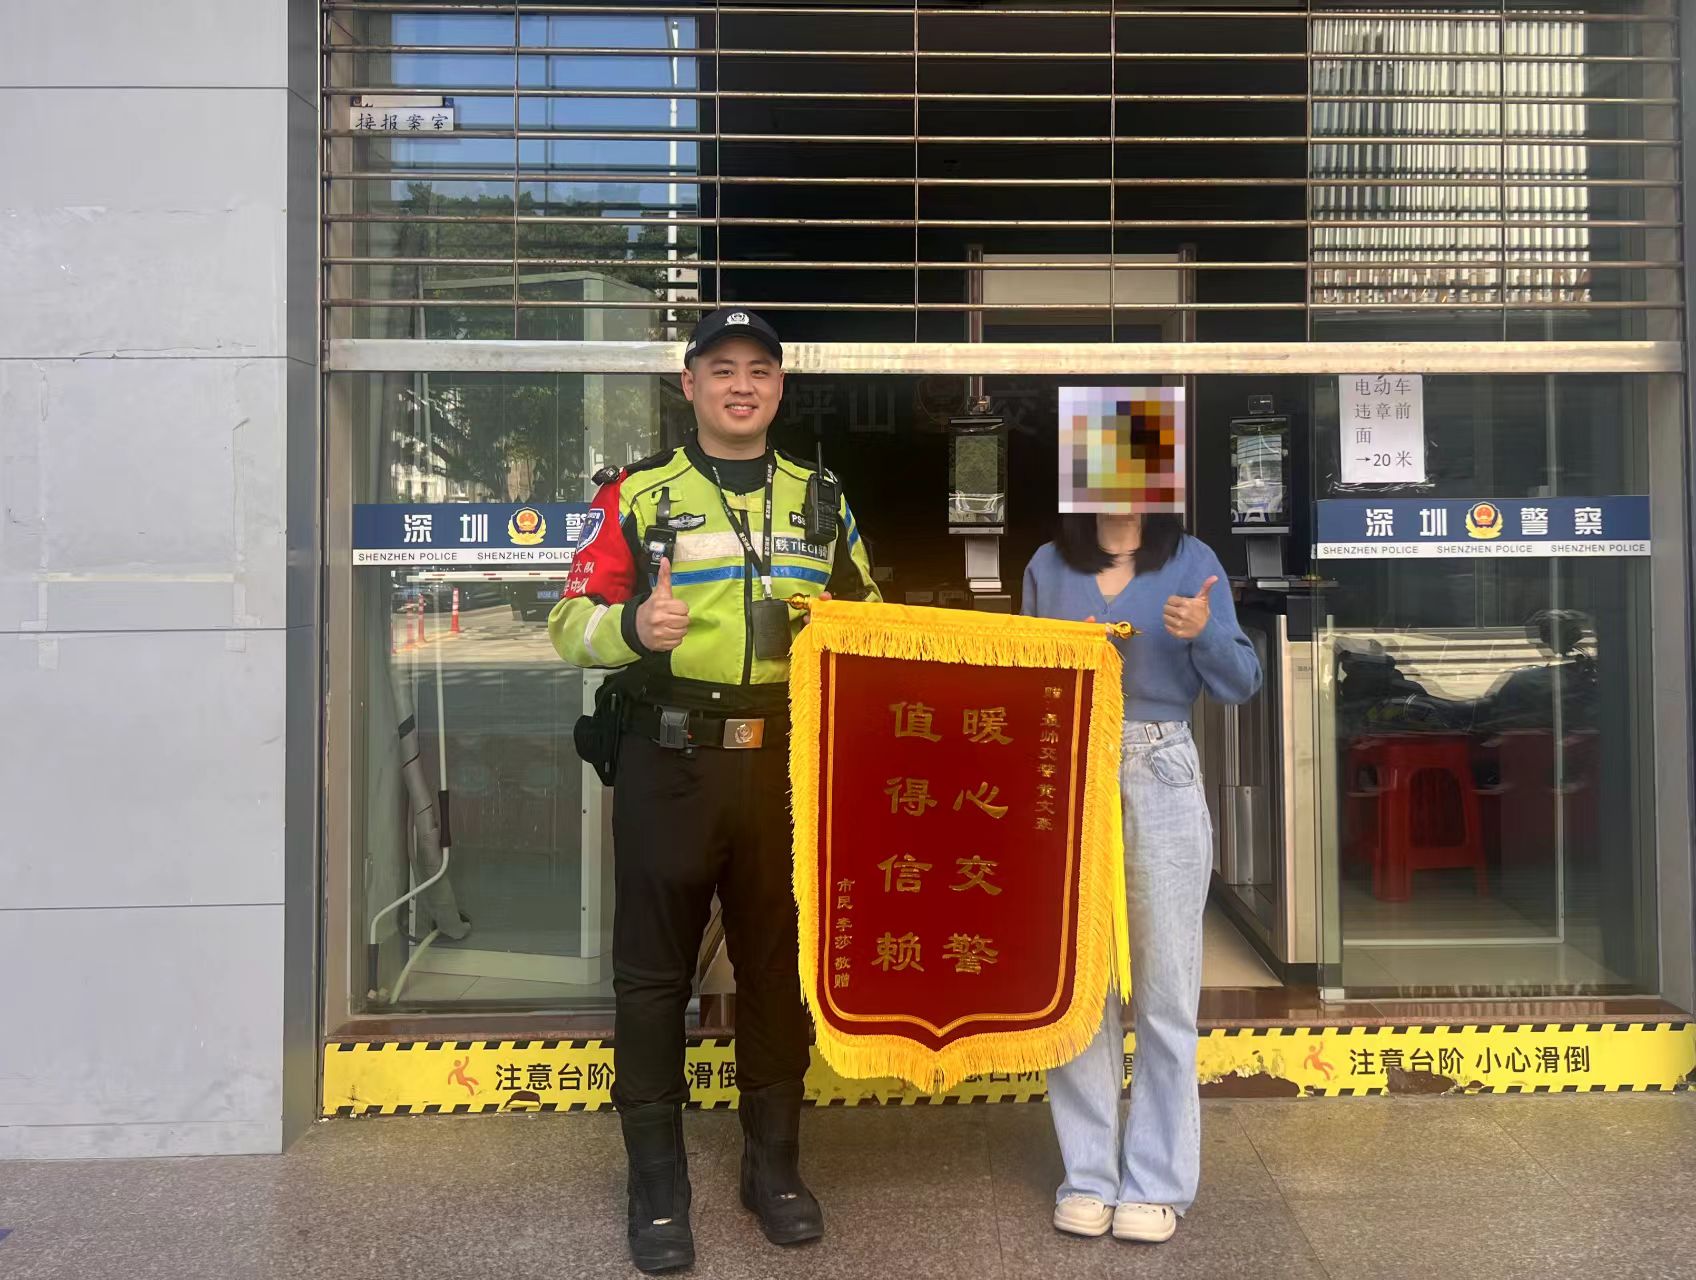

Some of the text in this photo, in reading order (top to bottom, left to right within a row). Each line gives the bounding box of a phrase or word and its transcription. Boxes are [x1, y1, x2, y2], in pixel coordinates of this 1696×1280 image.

[355, 113, 449, 131] 接报案室
[1355, 378, 1412, 396] 电动车
[1354, 402, 1412, 420] 违章前
[1355, 426, 1373, 444] 面
[403, 513, 489, 543] 深圳
[1365, 506, 1603, 537] 深圳 警察
[358, 553, 415, 561] SHENZHEN
[419, 552, 458, 561] POLICE
[477, 552, 534, 560] SHENZHEN
[1323, 543, 1646, 554] SHENZHEN POLICE SHENZHEN POLICE SHENZHEN POLICE
[570, 560, 595, 574] 大队
[871, 701, 943, 972] 值得信赖
[942, 706, 1014, 975] 暖心交警
[1349, 1045, 1590, 1076] 注意台阶 小心滑倒
[494, 1062, 615, 1091] 注意台阶
